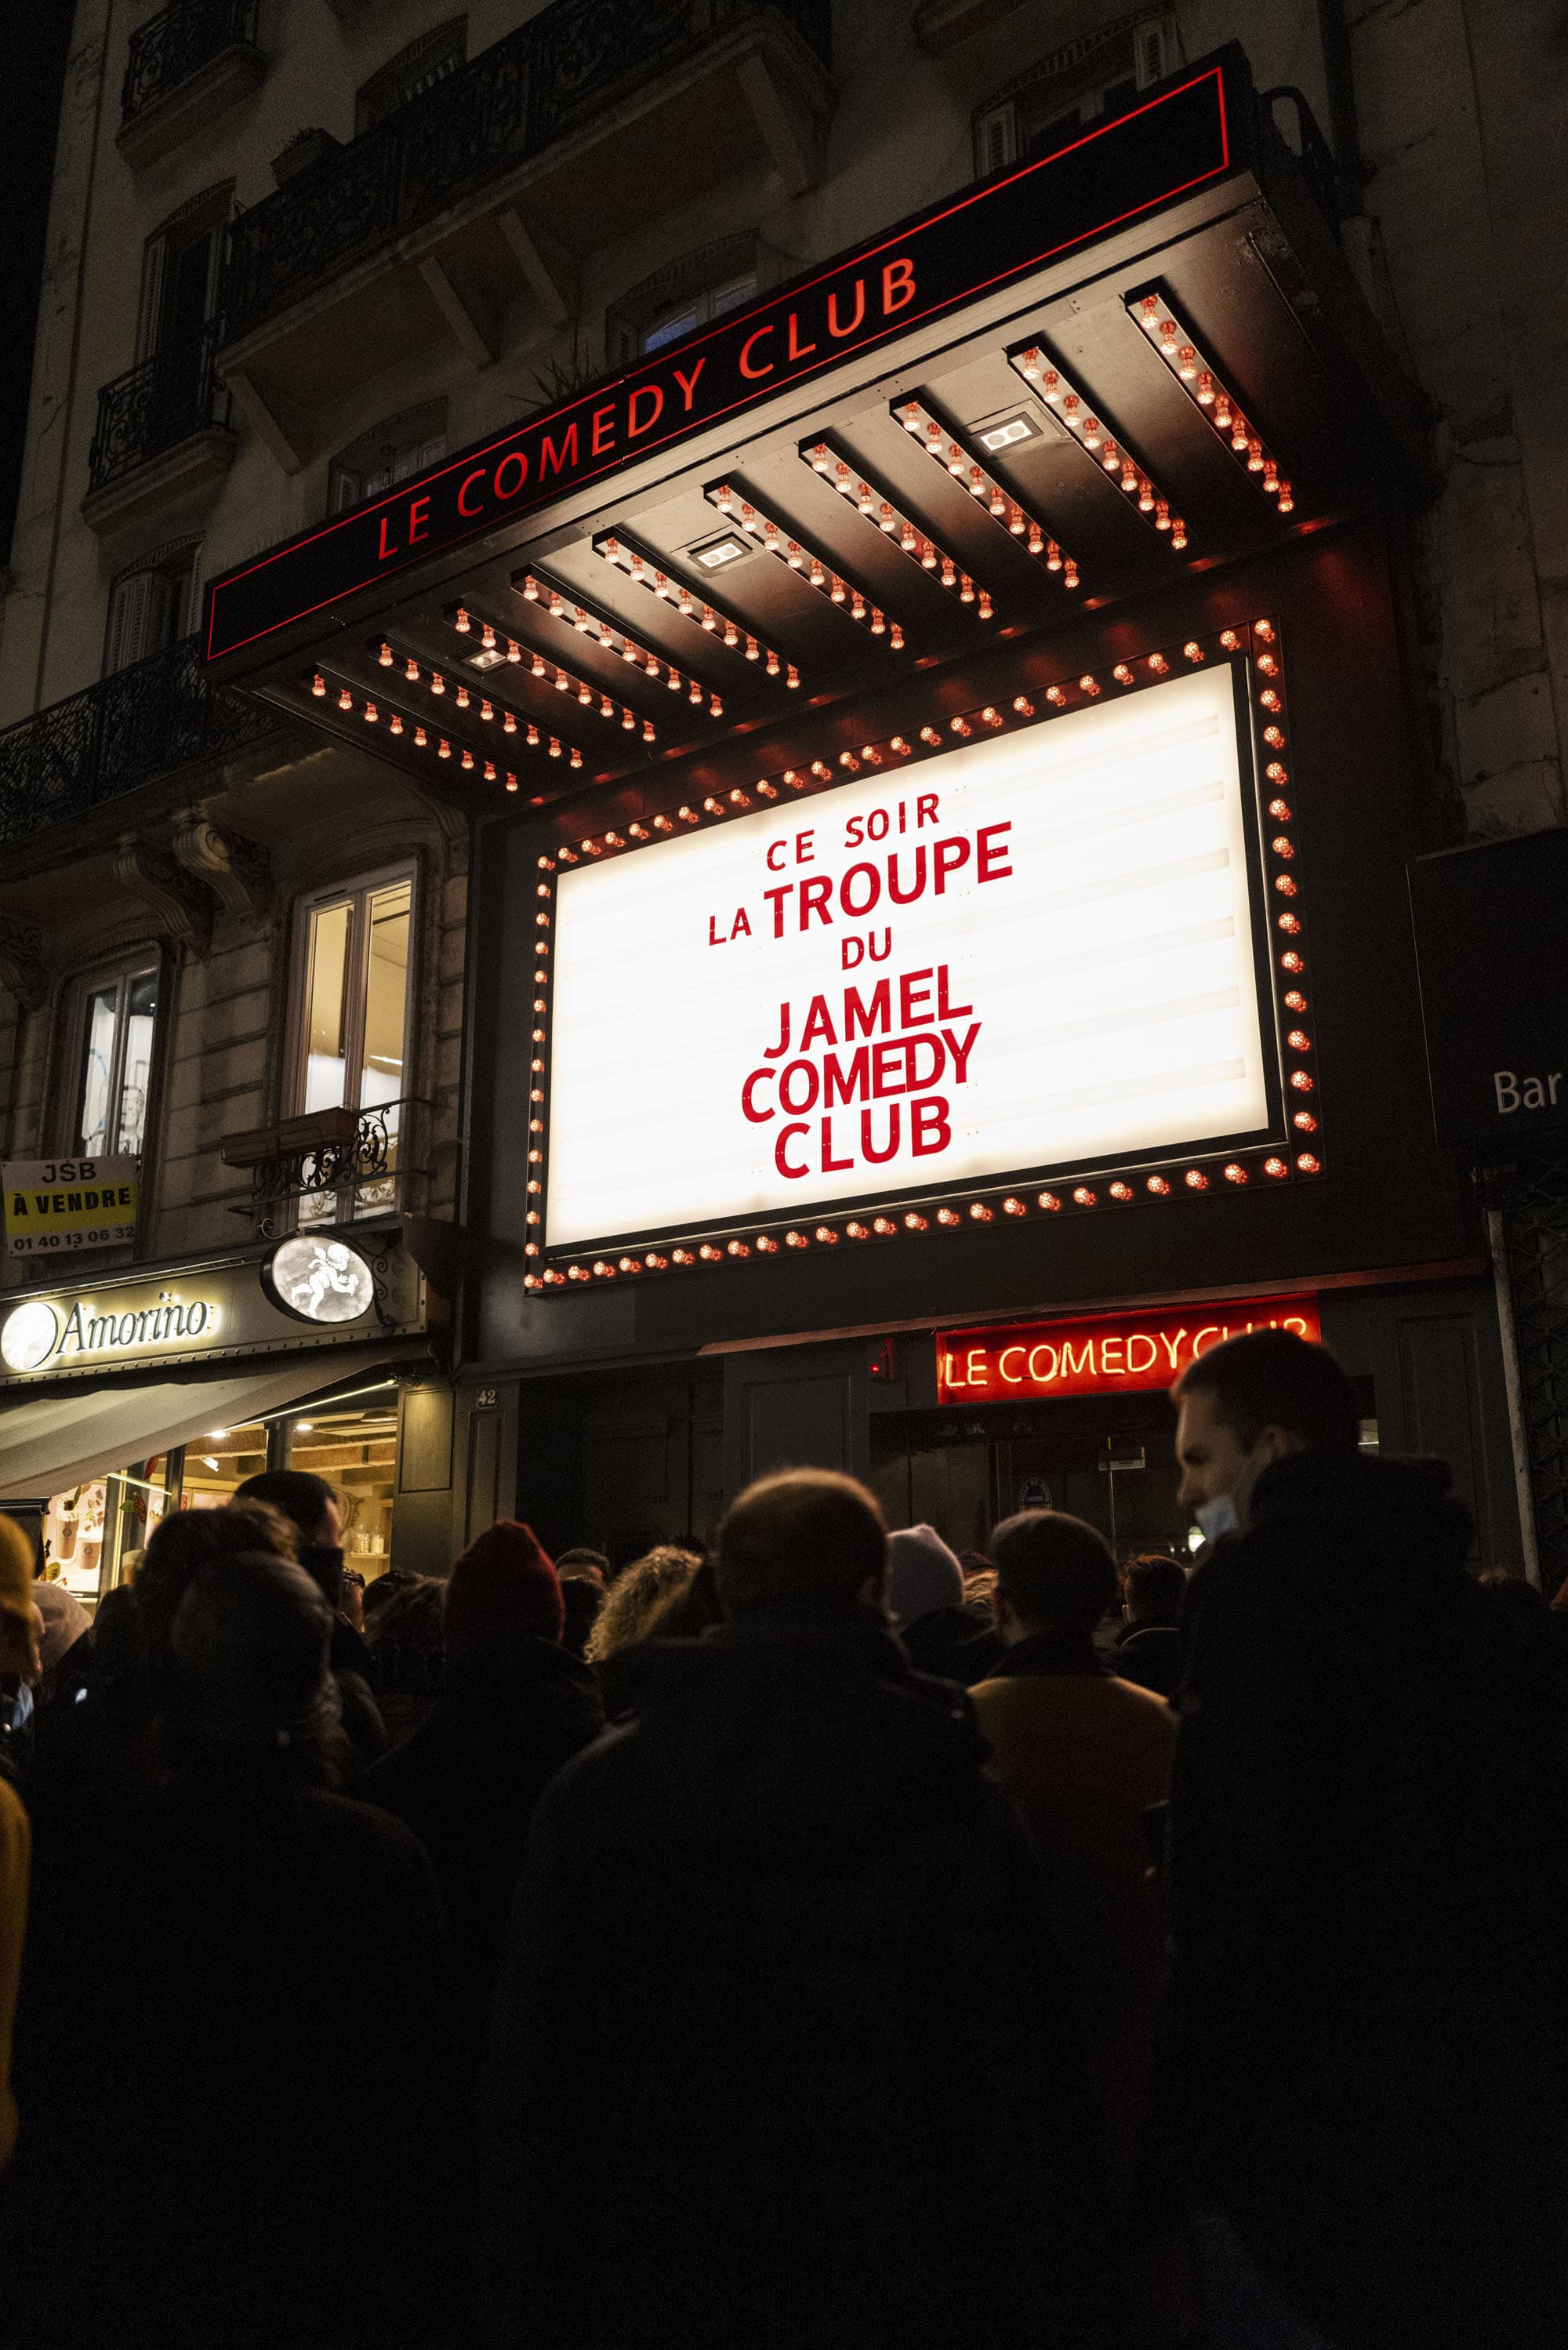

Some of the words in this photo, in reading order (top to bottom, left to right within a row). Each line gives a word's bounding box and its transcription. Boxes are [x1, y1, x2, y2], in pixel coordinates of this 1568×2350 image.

[378, 496, 430, 561] LE
[457, 358, 706, 518] COMEDY
[739, 257, 916, 380] CLUB
[767, 830, 815, 871] CE
[844, 793, 940, 848] SOIR
[709, 907, 752, 946] LA
[764, 821, 1013, 939] TROUPE
[841, 927, 892, 970] DU
[764, 964, 973, 1059] JAMEL
[742, 1022, 982, 1123] COMEDY
[1494, 1070, 1562, 1113] Bar
[775, 1095, 952, 1179] CLUB
[13, 1193, 28, 1215] À
[35, 1187, 131, 1215] VENDRE
[42, 1162, 96, 1183] JSB
[13, 1238, 33, 1250] 01
[38, 1236, 60, 1248] 40
[65, 1233, 83, 1245] 13
[88, 1229, 111, 1243] 06
[114, 1226, 136, 1239] 32
[56, 1291, 208, 1354] Amorino
[944, 1349, 988, 1388] LE
[998, 1328, 1187, 1382] COMEDY
[478, 1388, 497, 1405] 42
